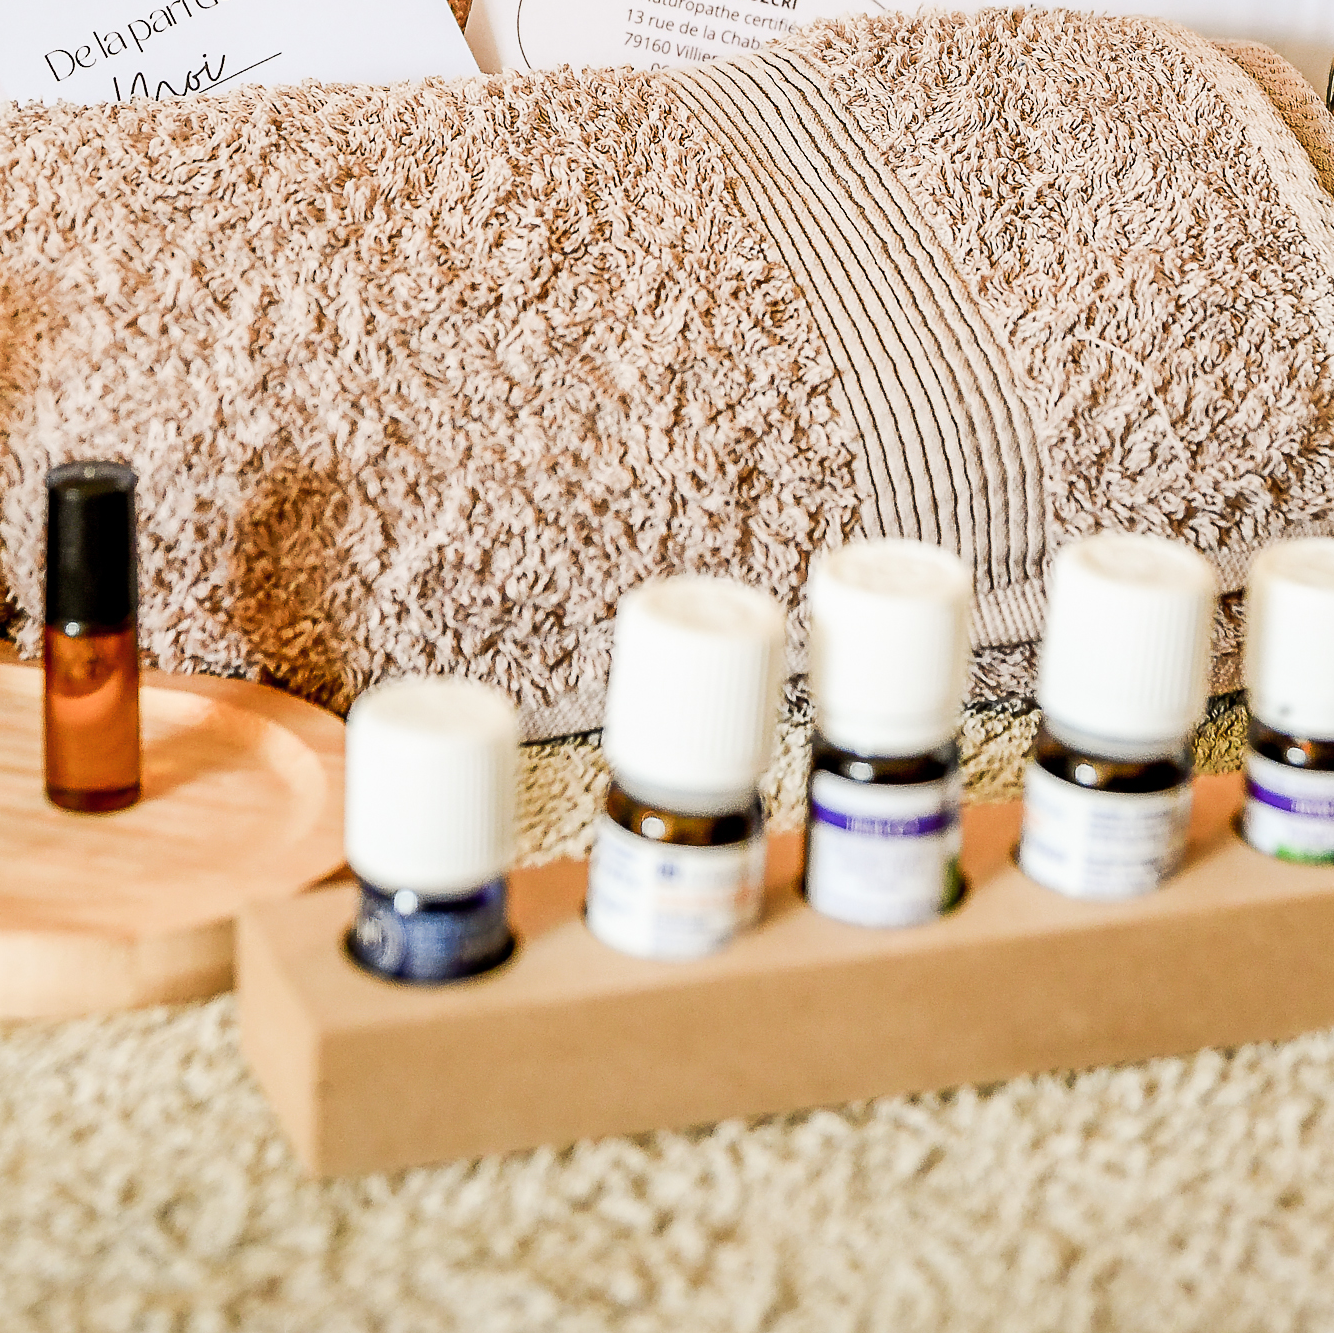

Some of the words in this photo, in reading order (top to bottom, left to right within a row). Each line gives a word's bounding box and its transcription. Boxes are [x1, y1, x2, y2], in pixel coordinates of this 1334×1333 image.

[627, 8, 644, 25] 13
[648, 14, 675, 32] rue
[679, 19, 699, 37] de
[702, 24, 716, 41] la
[721, 29, 762, 51] Chab
[743, 12, 796, 36] certifié
[44, 45, 97, 82] De
[93, 31, 128, 58] la
[624, 31, 671, 55] 79160
